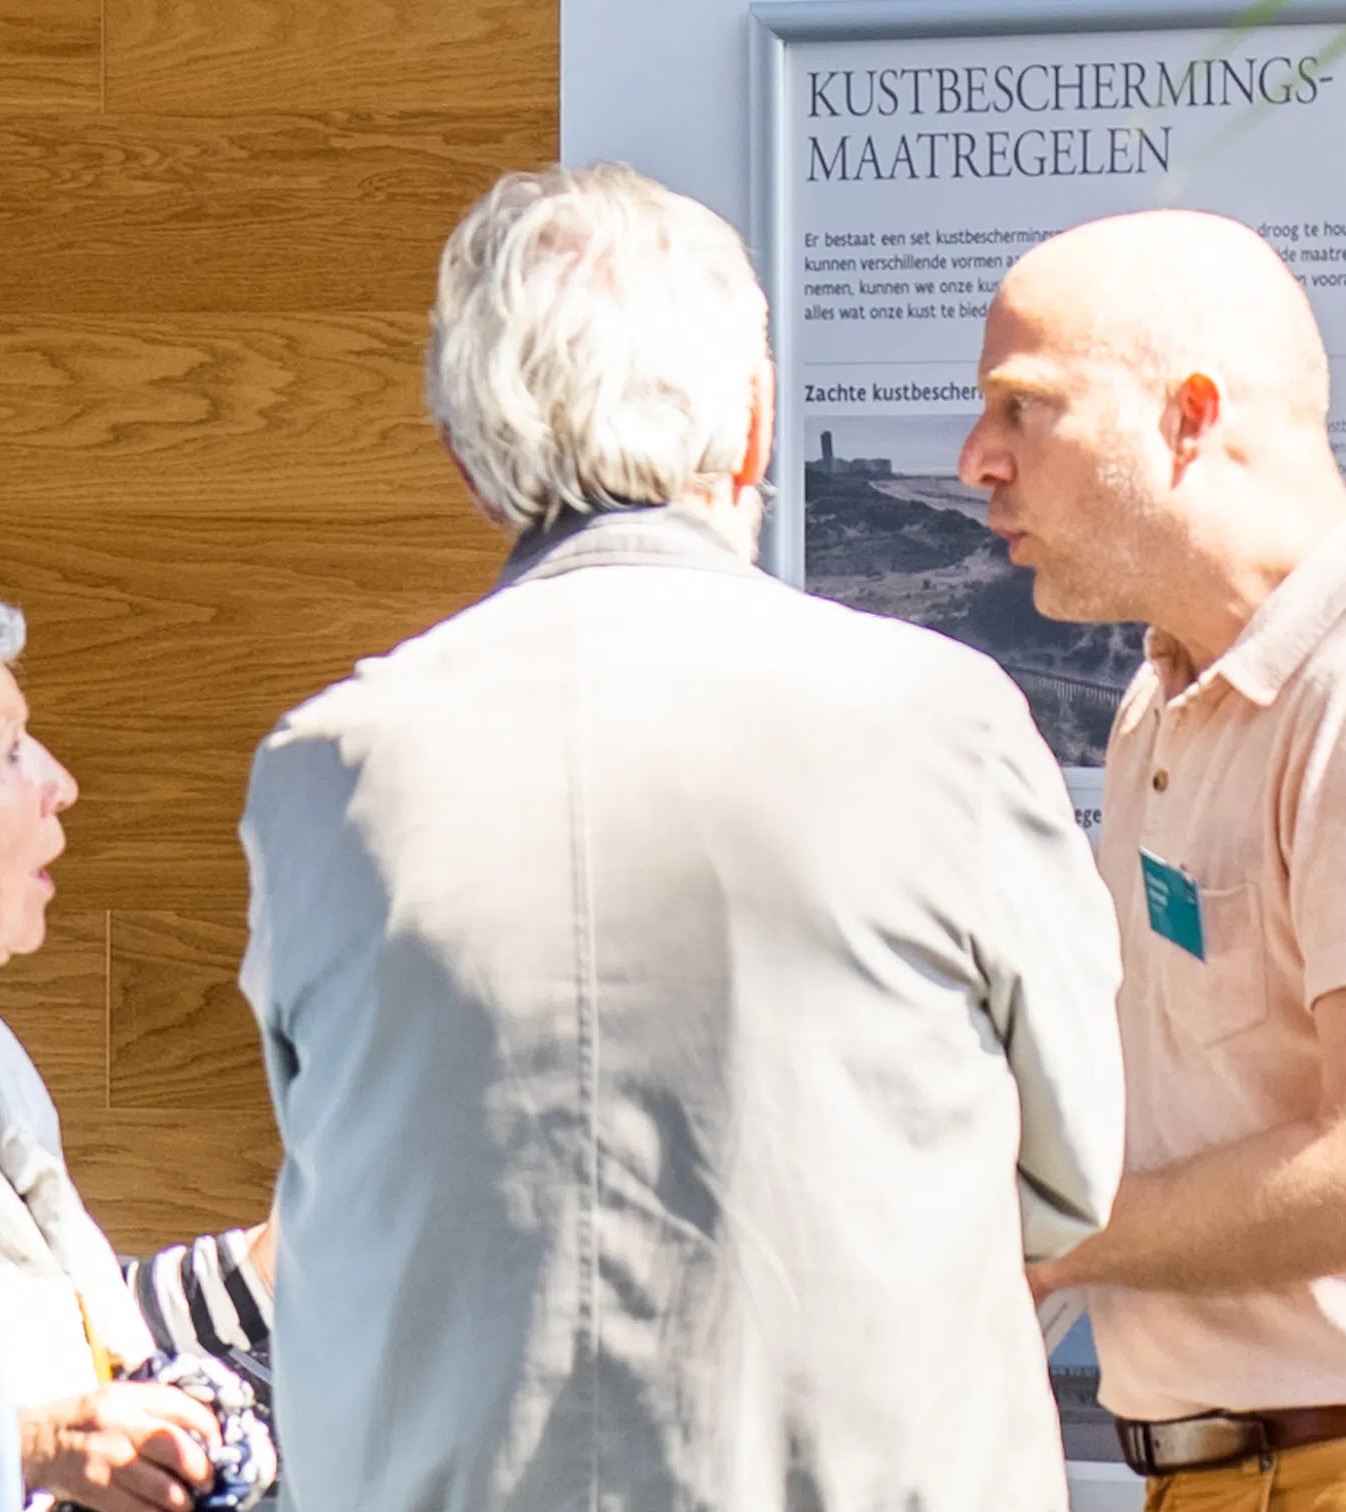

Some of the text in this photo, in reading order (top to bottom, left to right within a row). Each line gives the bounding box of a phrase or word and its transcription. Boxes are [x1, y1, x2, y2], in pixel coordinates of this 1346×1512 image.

[806, 56, 1334, 118] KUSTBESCHERMINGS-
[806, 127, 1173, 182] MAATREGELEN
[805, 231, 818, 247] Er
[825, 231, 876, 247] bestaat
[881, 234, 905, 246] een
[910, 230, 931, 245] set
[1258, 221, 1299, 241] droog
[1305, 222, 1319, 237] te
[805, 255, 855, 272] kunnen
[861, 253, 946, 271] verschillende
[952, 256, 1002, 269] vormen
[805, 284, 853, 297] nemen,
[860, 279, 909, 295] kunnen
[914, 282, 934, 294] we
[939, 281, 973, 293] onze
[805, 304, 834, 321] alles
[840, 305, 864, 320] wat
[870, 307, 903, 319] onze
[907, 302, 937, 319] kust
[942, 303, 954, 318] te
[805, 383, 866, 402] Zachte
